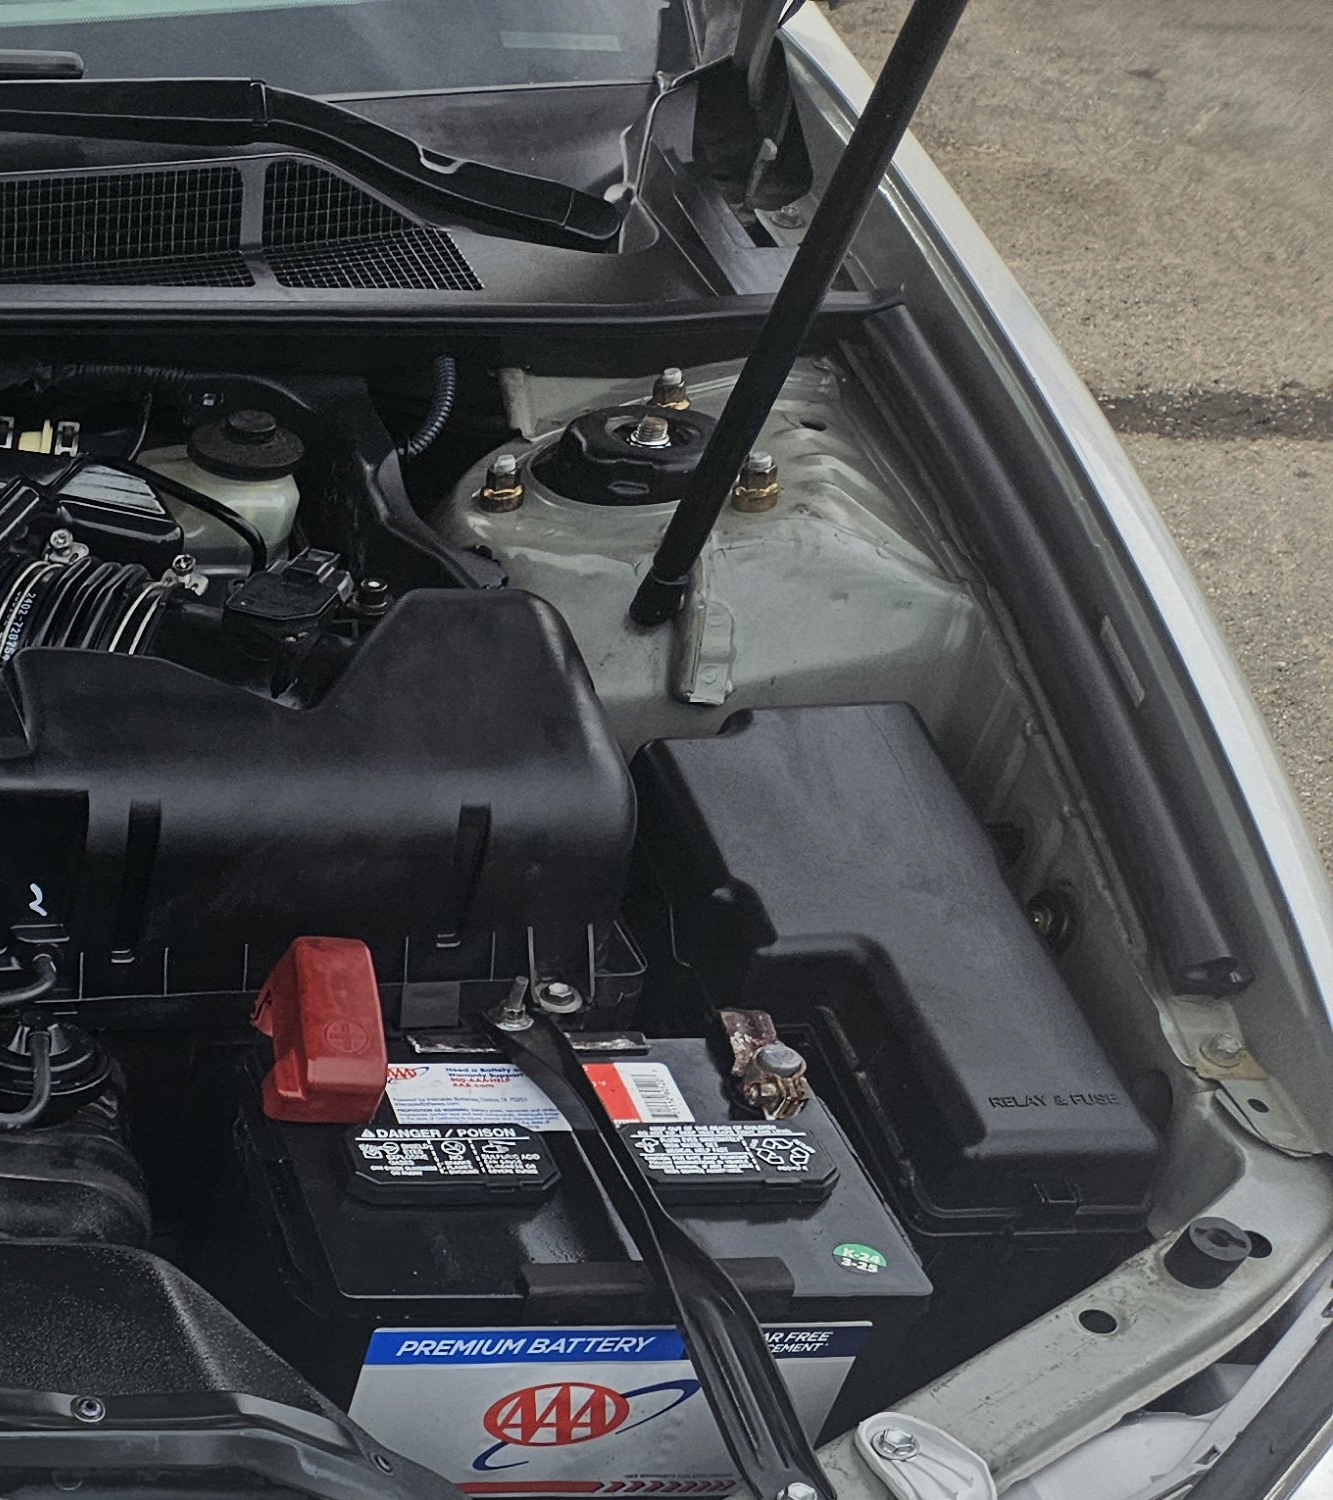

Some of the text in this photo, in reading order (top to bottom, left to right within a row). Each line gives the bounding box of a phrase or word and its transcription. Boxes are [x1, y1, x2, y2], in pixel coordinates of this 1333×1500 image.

[988, 1094, 1047, 1107] RELAY
[1069, 1093, 1121, 1105] FUSE
[376, 1128, 516, 1138] DANGER / POISON
[843, 1247, 880, 1264] K-24
[841, 1257, 878, 1273] 3-25
[784, 1331, 833, 1342] FREE
[396, 1336, 657, 1358] PREMIUM BATTERY
[491, 1383, 619, 1446] AAA
